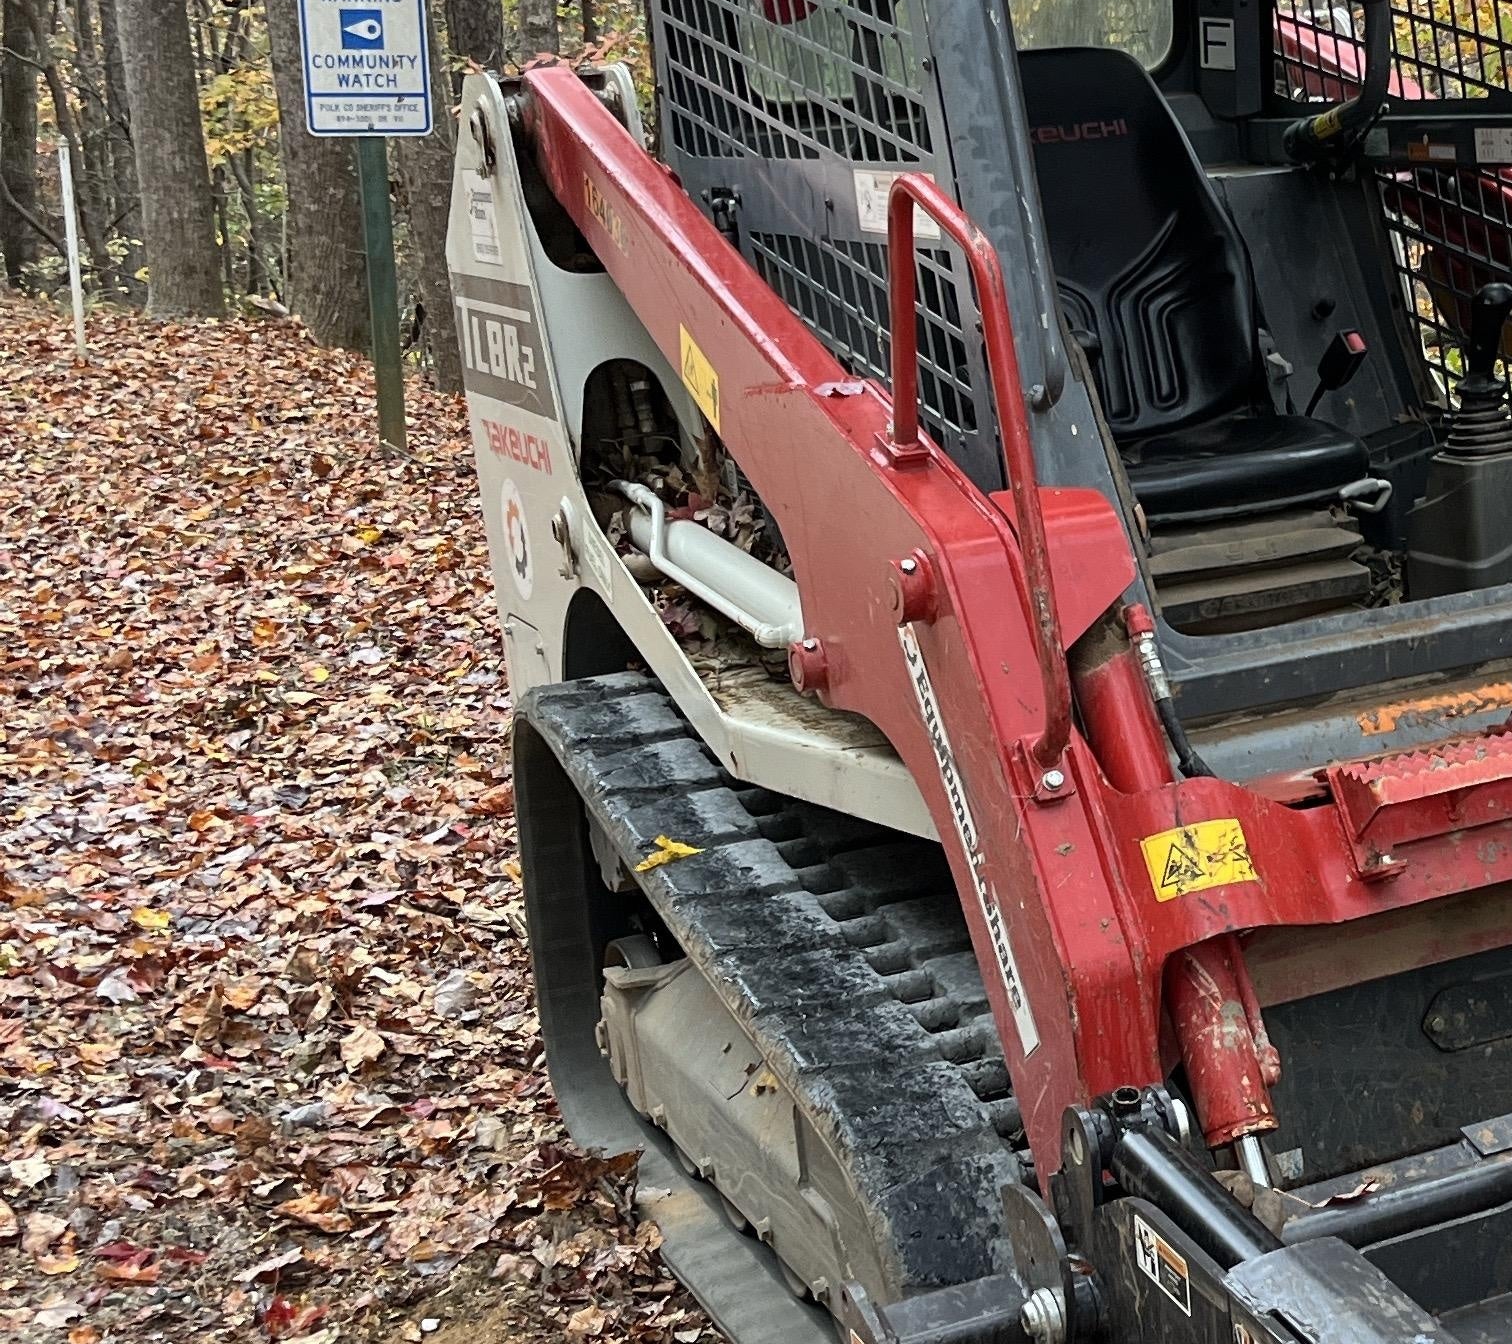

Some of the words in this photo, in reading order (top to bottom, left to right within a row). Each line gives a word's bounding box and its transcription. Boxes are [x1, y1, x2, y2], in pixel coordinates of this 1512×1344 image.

[1202, 21, 1231, 64] F
[312, 54, 418, 70] COMMUNITY
[337, 73, 398, 88] WATCH
